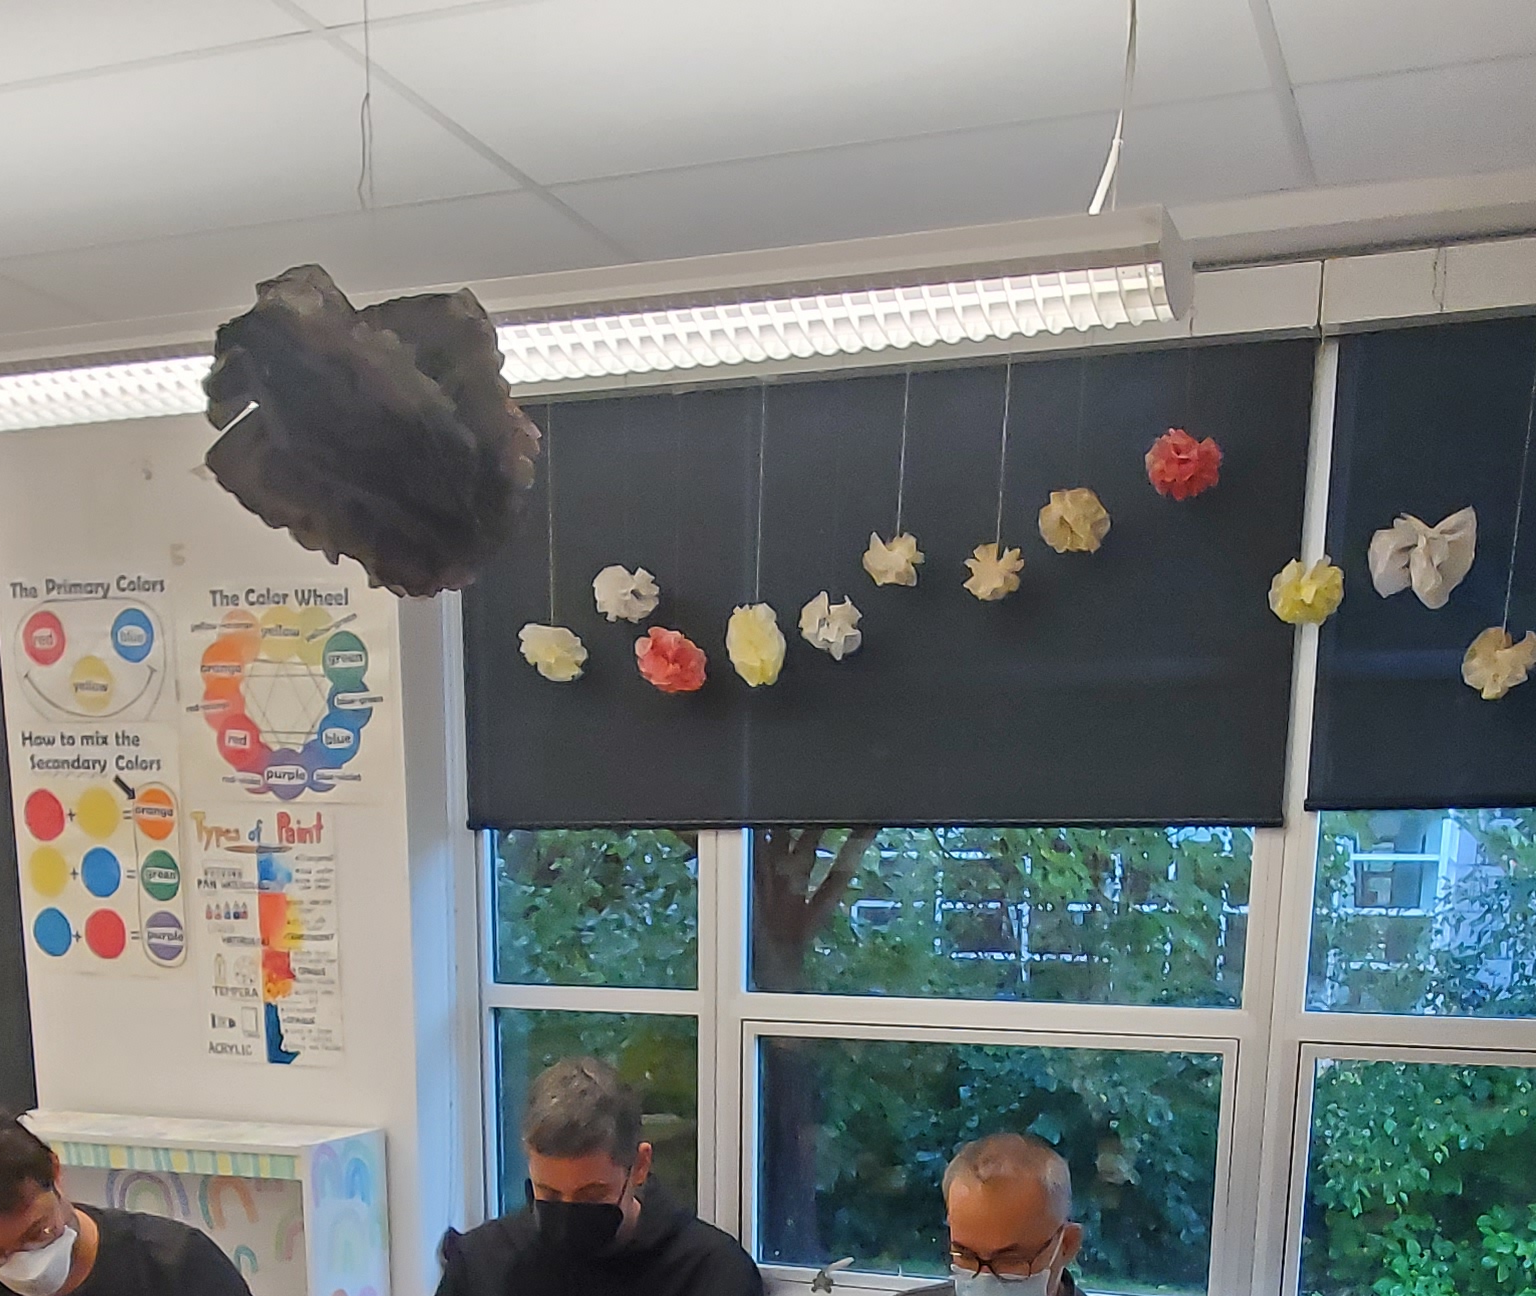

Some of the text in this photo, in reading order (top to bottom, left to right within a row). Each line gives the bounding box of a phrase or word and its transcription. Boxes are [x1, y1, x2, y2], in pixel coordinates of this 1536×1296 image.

[10, 575, 166, 599] The Primary Colors
[209, 587, 349, 607] The Color Wheel
[120, 631, 144, 643] blue
[261, 624, 300, 638] yellow
[35, 632, 53, 646] red
[73, 680, 109, 693] yellow
[21, 730, 140, 747] How to mix the
[228, 734, 247, 746] red
[325, 733, 352, 745] blue
[30, 754, 162, 773] Secondary Colors
[266, 768, 306, 782] purple
[190, 811, 324, 851] Types of Paint
[212, 985, 259, 998] TEMPERA
[208, 1041, 253, 1056] ACRYLIC
